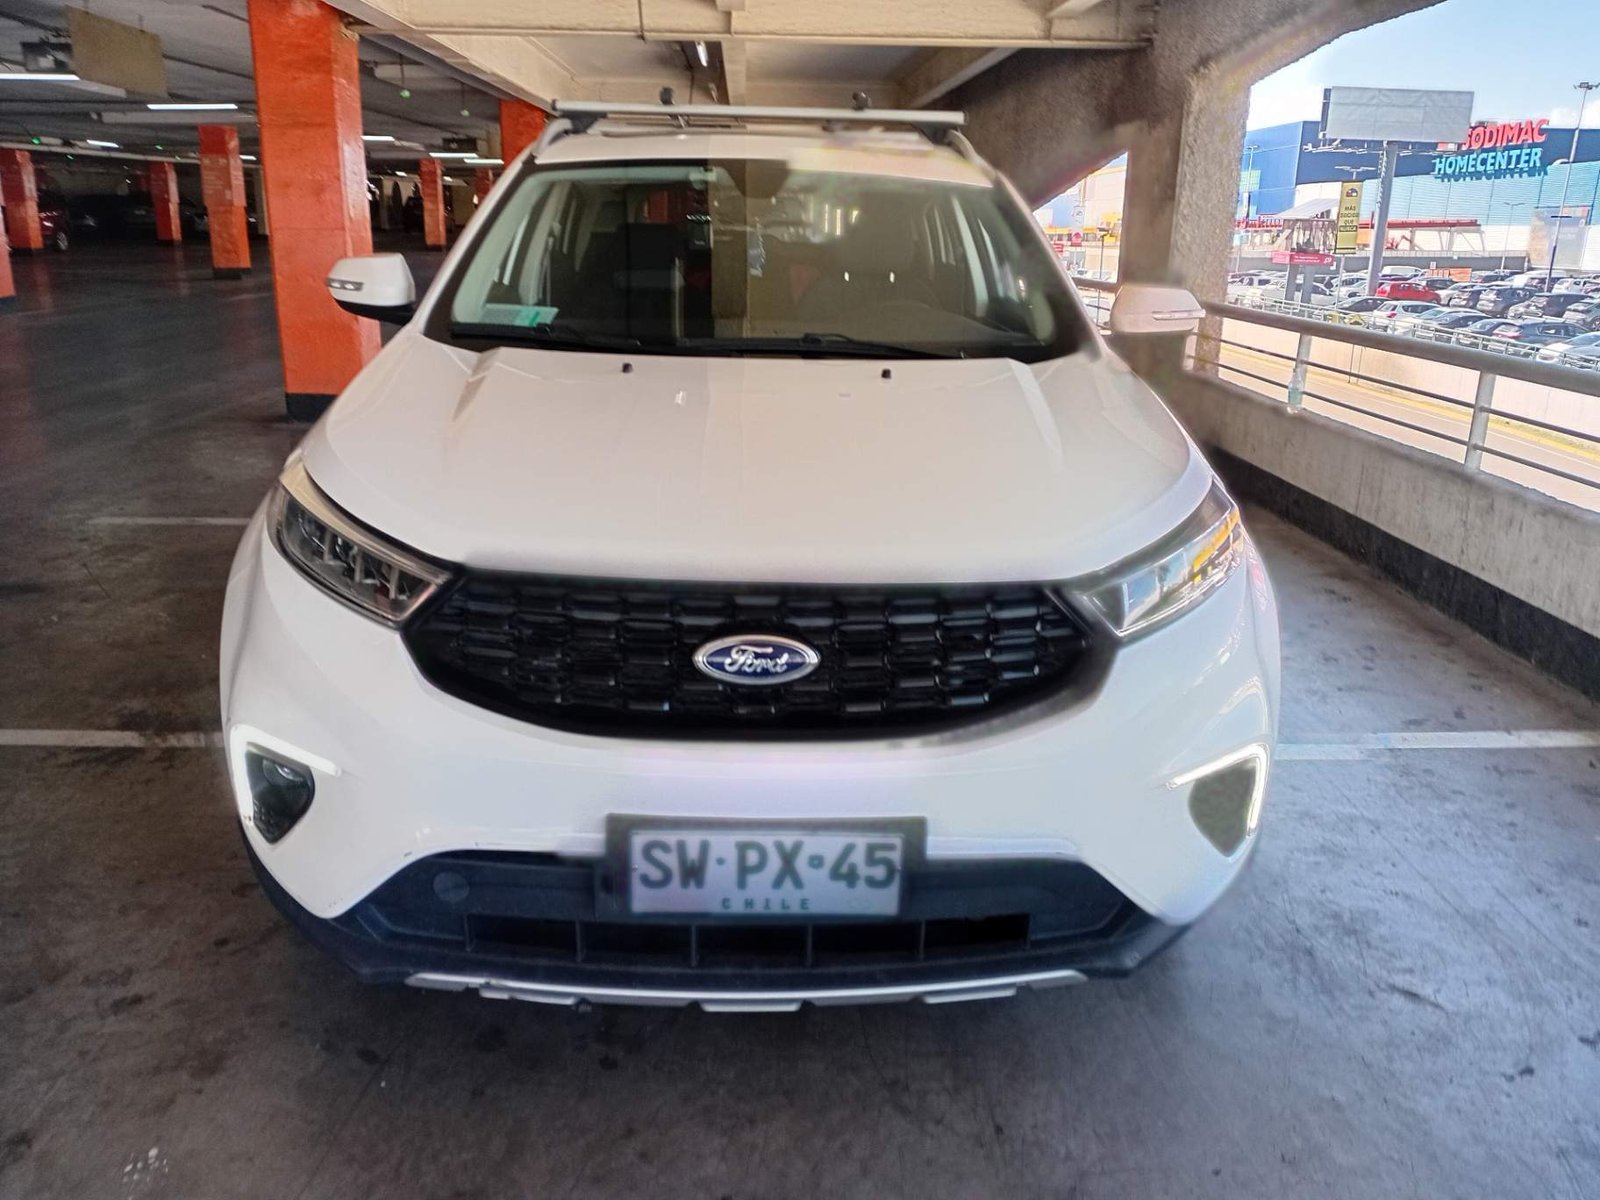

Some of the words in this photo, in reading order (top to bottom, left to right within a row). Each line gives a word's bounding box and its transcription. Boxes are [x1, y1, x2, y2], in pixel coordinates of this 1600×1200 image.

[1432, 148, 1542, 175] HOMECENTER
[724, 645, 789, 673] Ford
[721, 897, 810, 911] CHILE
